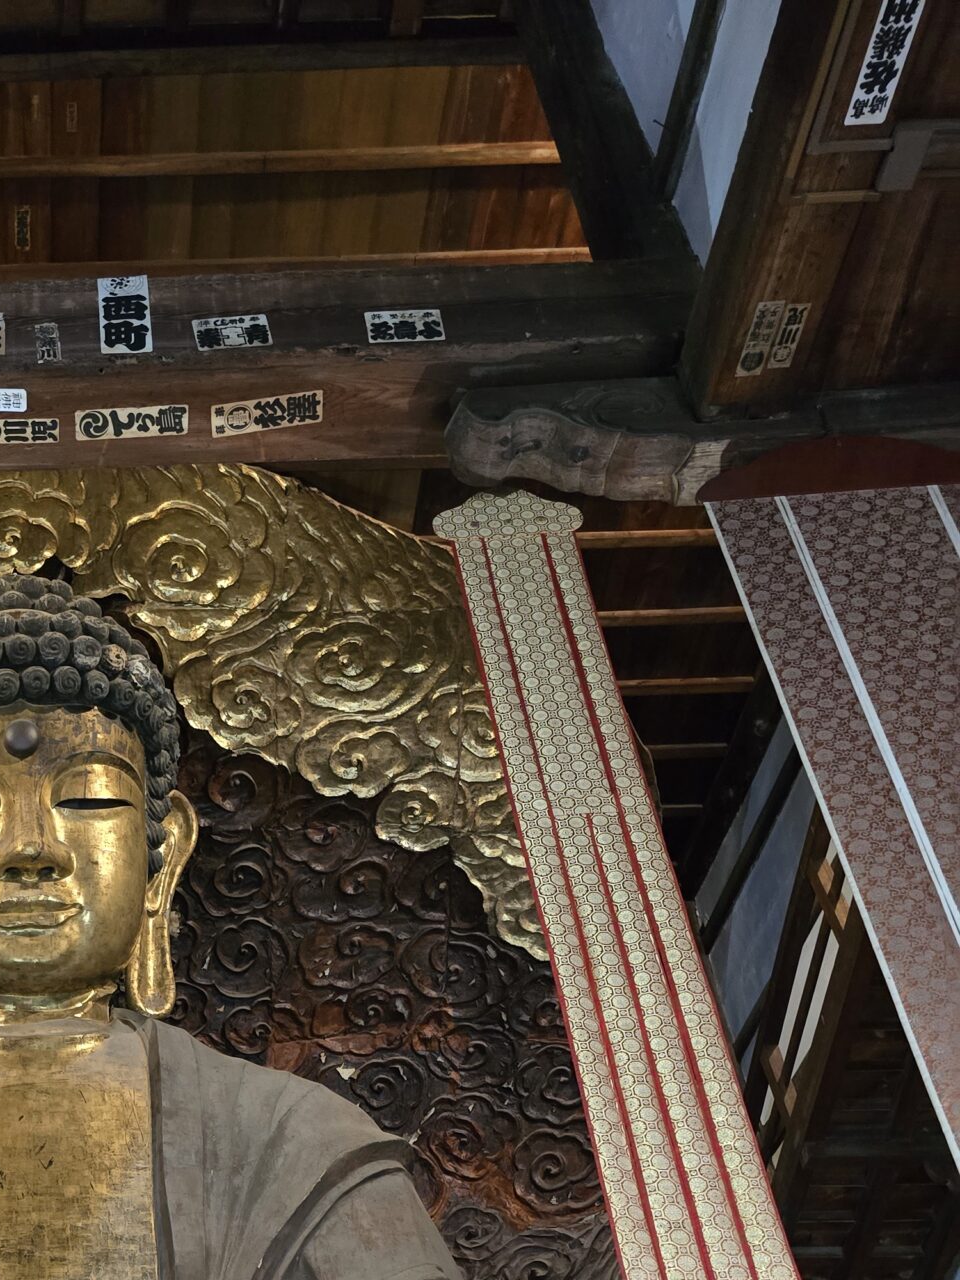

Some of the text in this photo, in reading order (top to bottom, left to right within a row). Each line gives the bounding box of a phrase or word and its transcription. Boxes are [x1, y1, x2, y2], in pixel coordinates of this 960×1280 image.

[101, 293, 150, 351] 西町
[109, 406, 187, 437] てら島
[253, 393, 320, 429] 杉澤
